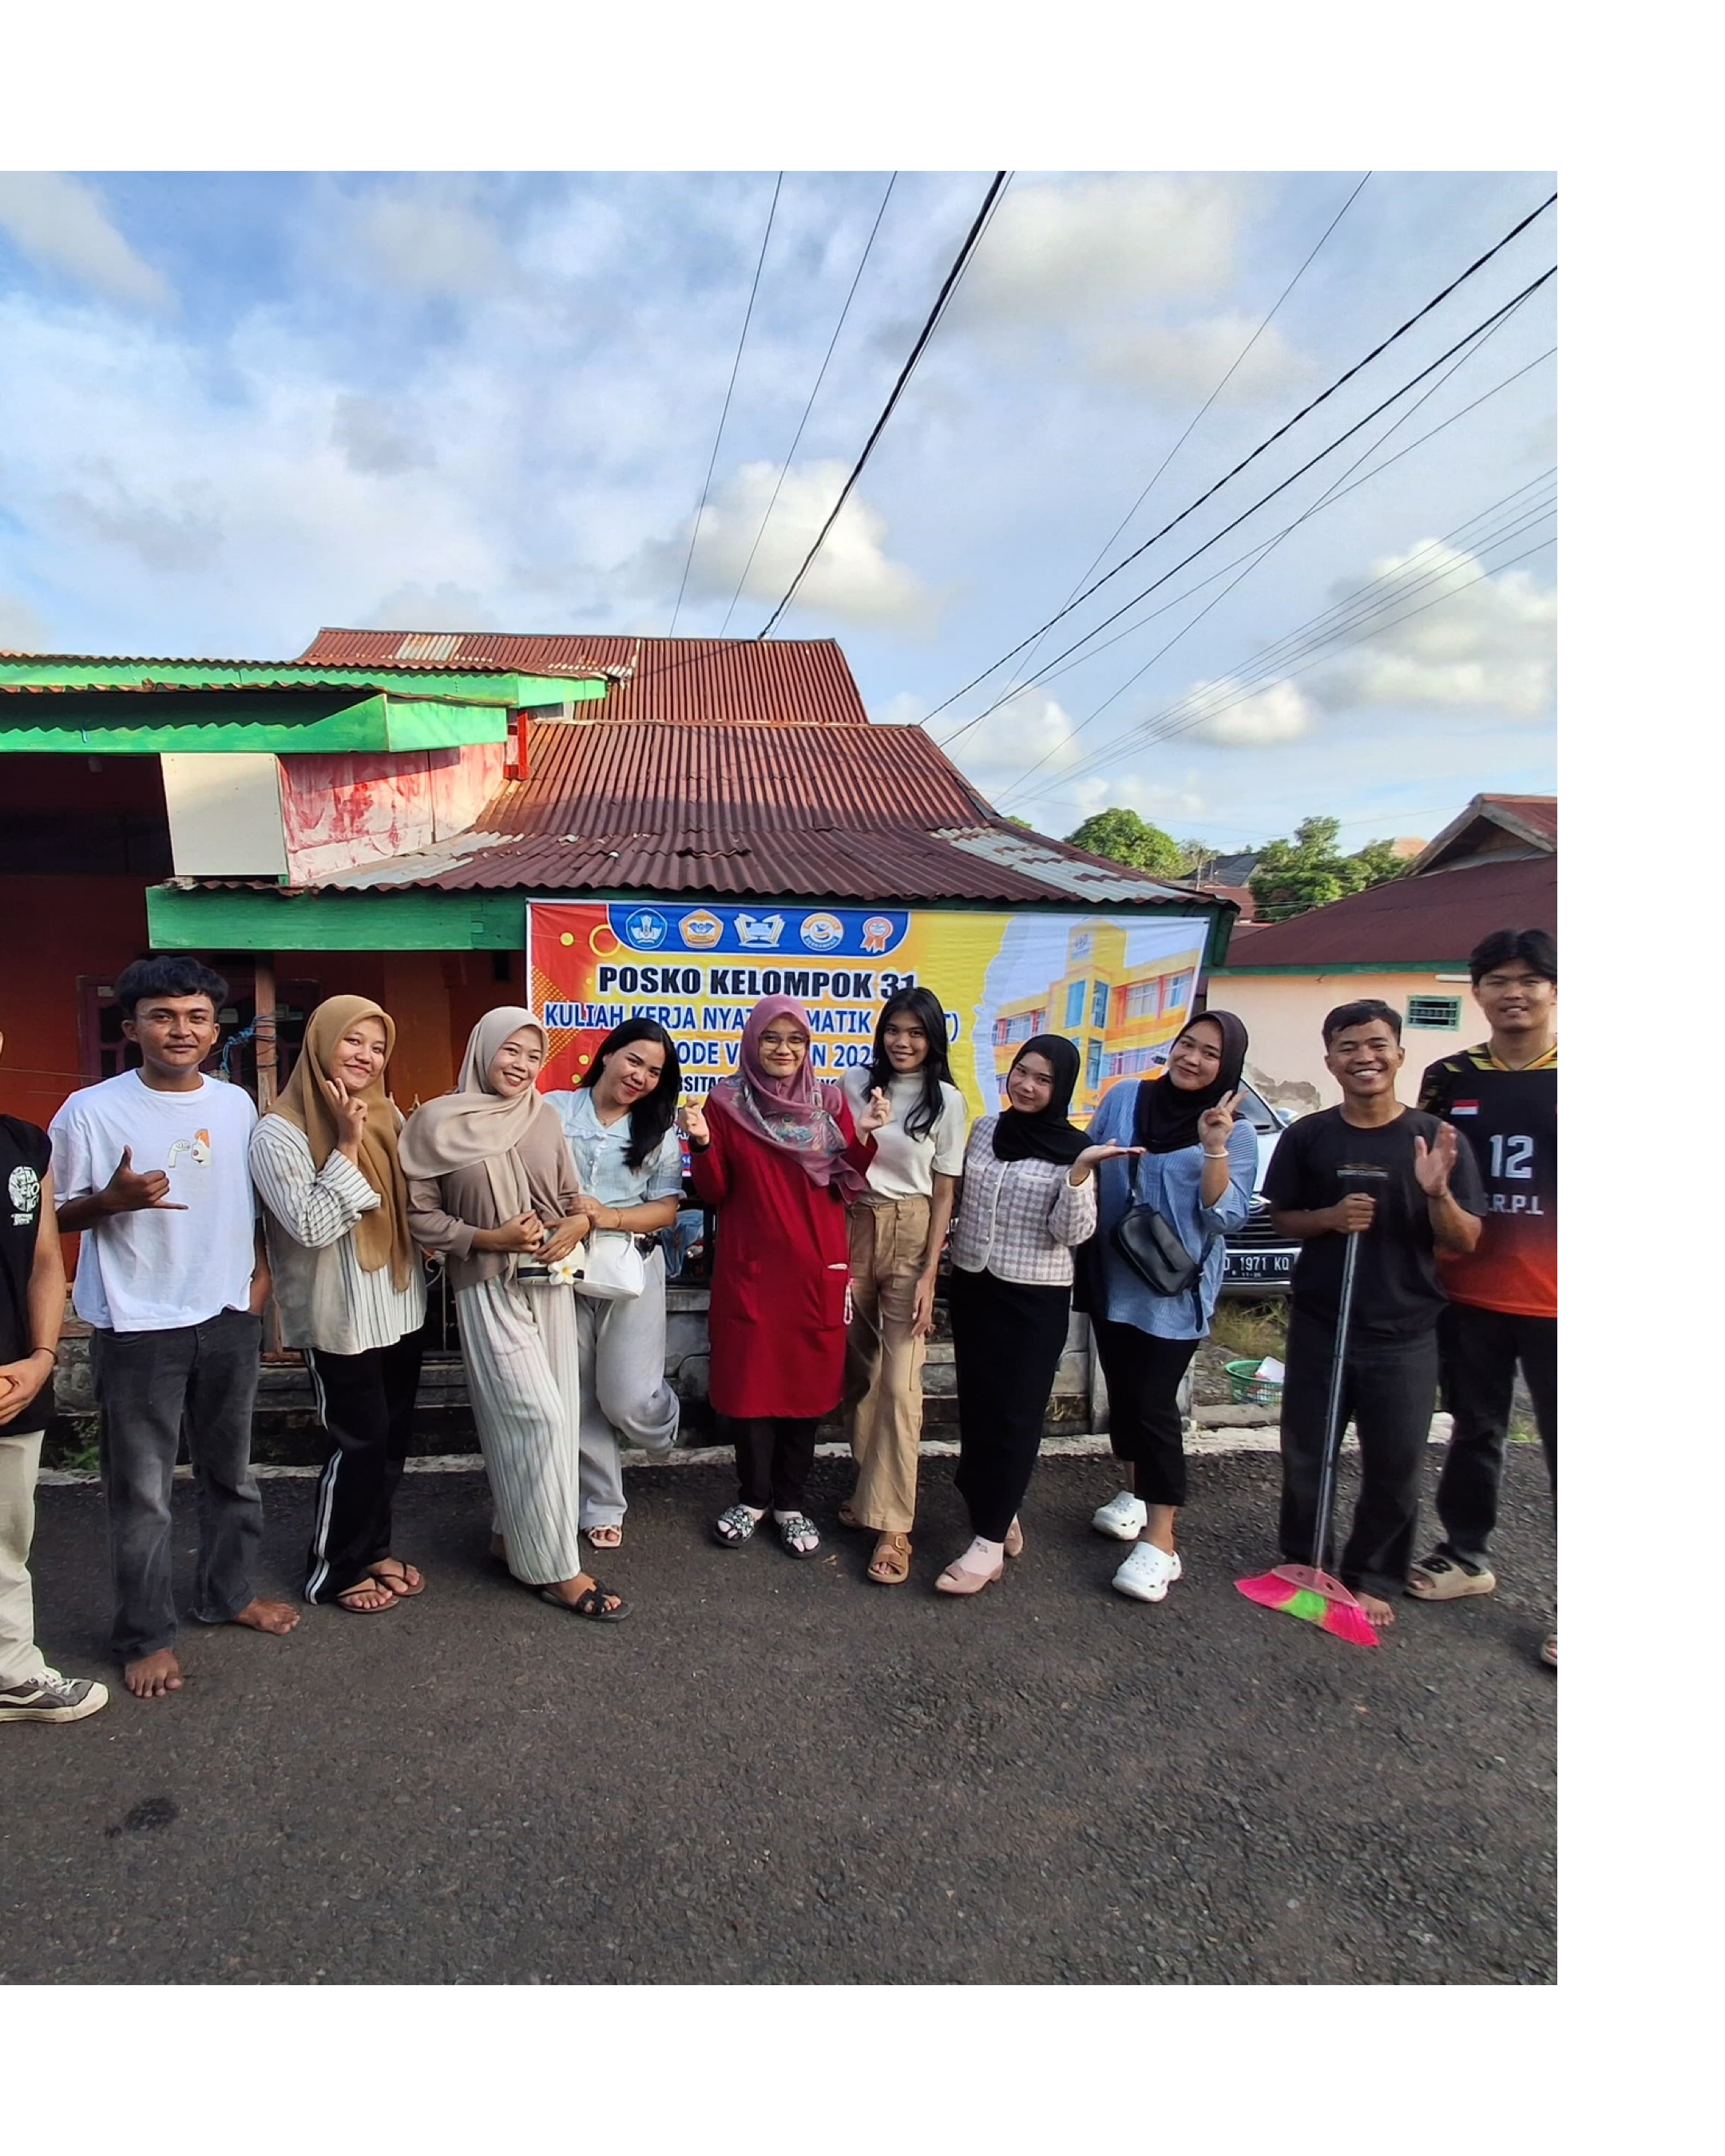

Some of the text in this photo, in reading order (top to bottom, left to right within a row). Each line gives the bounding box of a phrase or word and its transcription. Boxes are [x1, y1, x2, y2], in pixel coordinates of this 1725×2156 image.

[599, 966, 914, 999] POSKO KELOMPOK 31
[545, 1005, 623, 1027] KULIAH
[703, 1007, 753, 1030] NYA
[806, 1010, 872, 1033] MATIK
[677, 1041, 719, 1064] ODE
[834, 1044, 871, 1067] 202
[1489, 1134, 1533, 1179] 12
[1240, 1256, 1267, 1271] 1971
